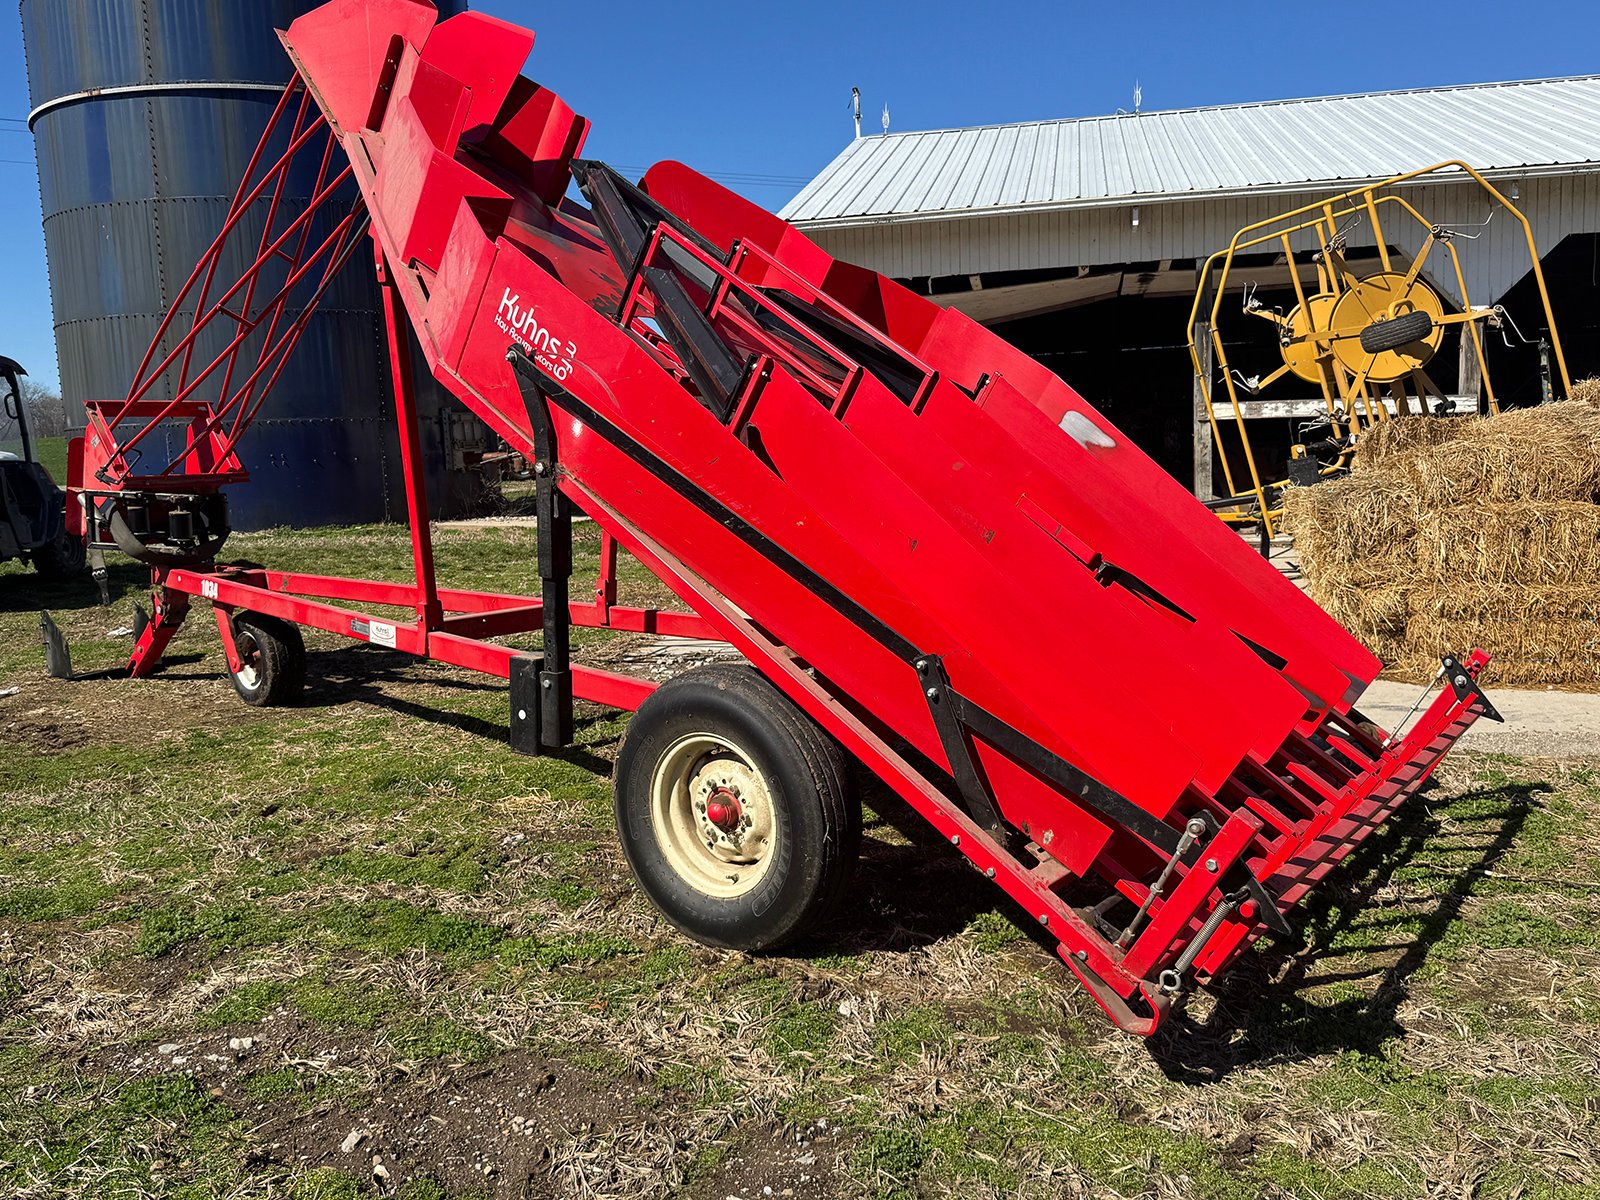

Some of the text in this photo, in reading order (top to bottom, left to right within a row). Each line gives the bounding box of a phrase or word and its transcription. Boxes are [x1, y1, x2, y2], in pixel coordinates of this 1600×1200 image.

[494, 314, 553, 371] Hay Accumtors
[498, 286, 561, 359] Kuhns
[201, 579, 218, 599] 1034
